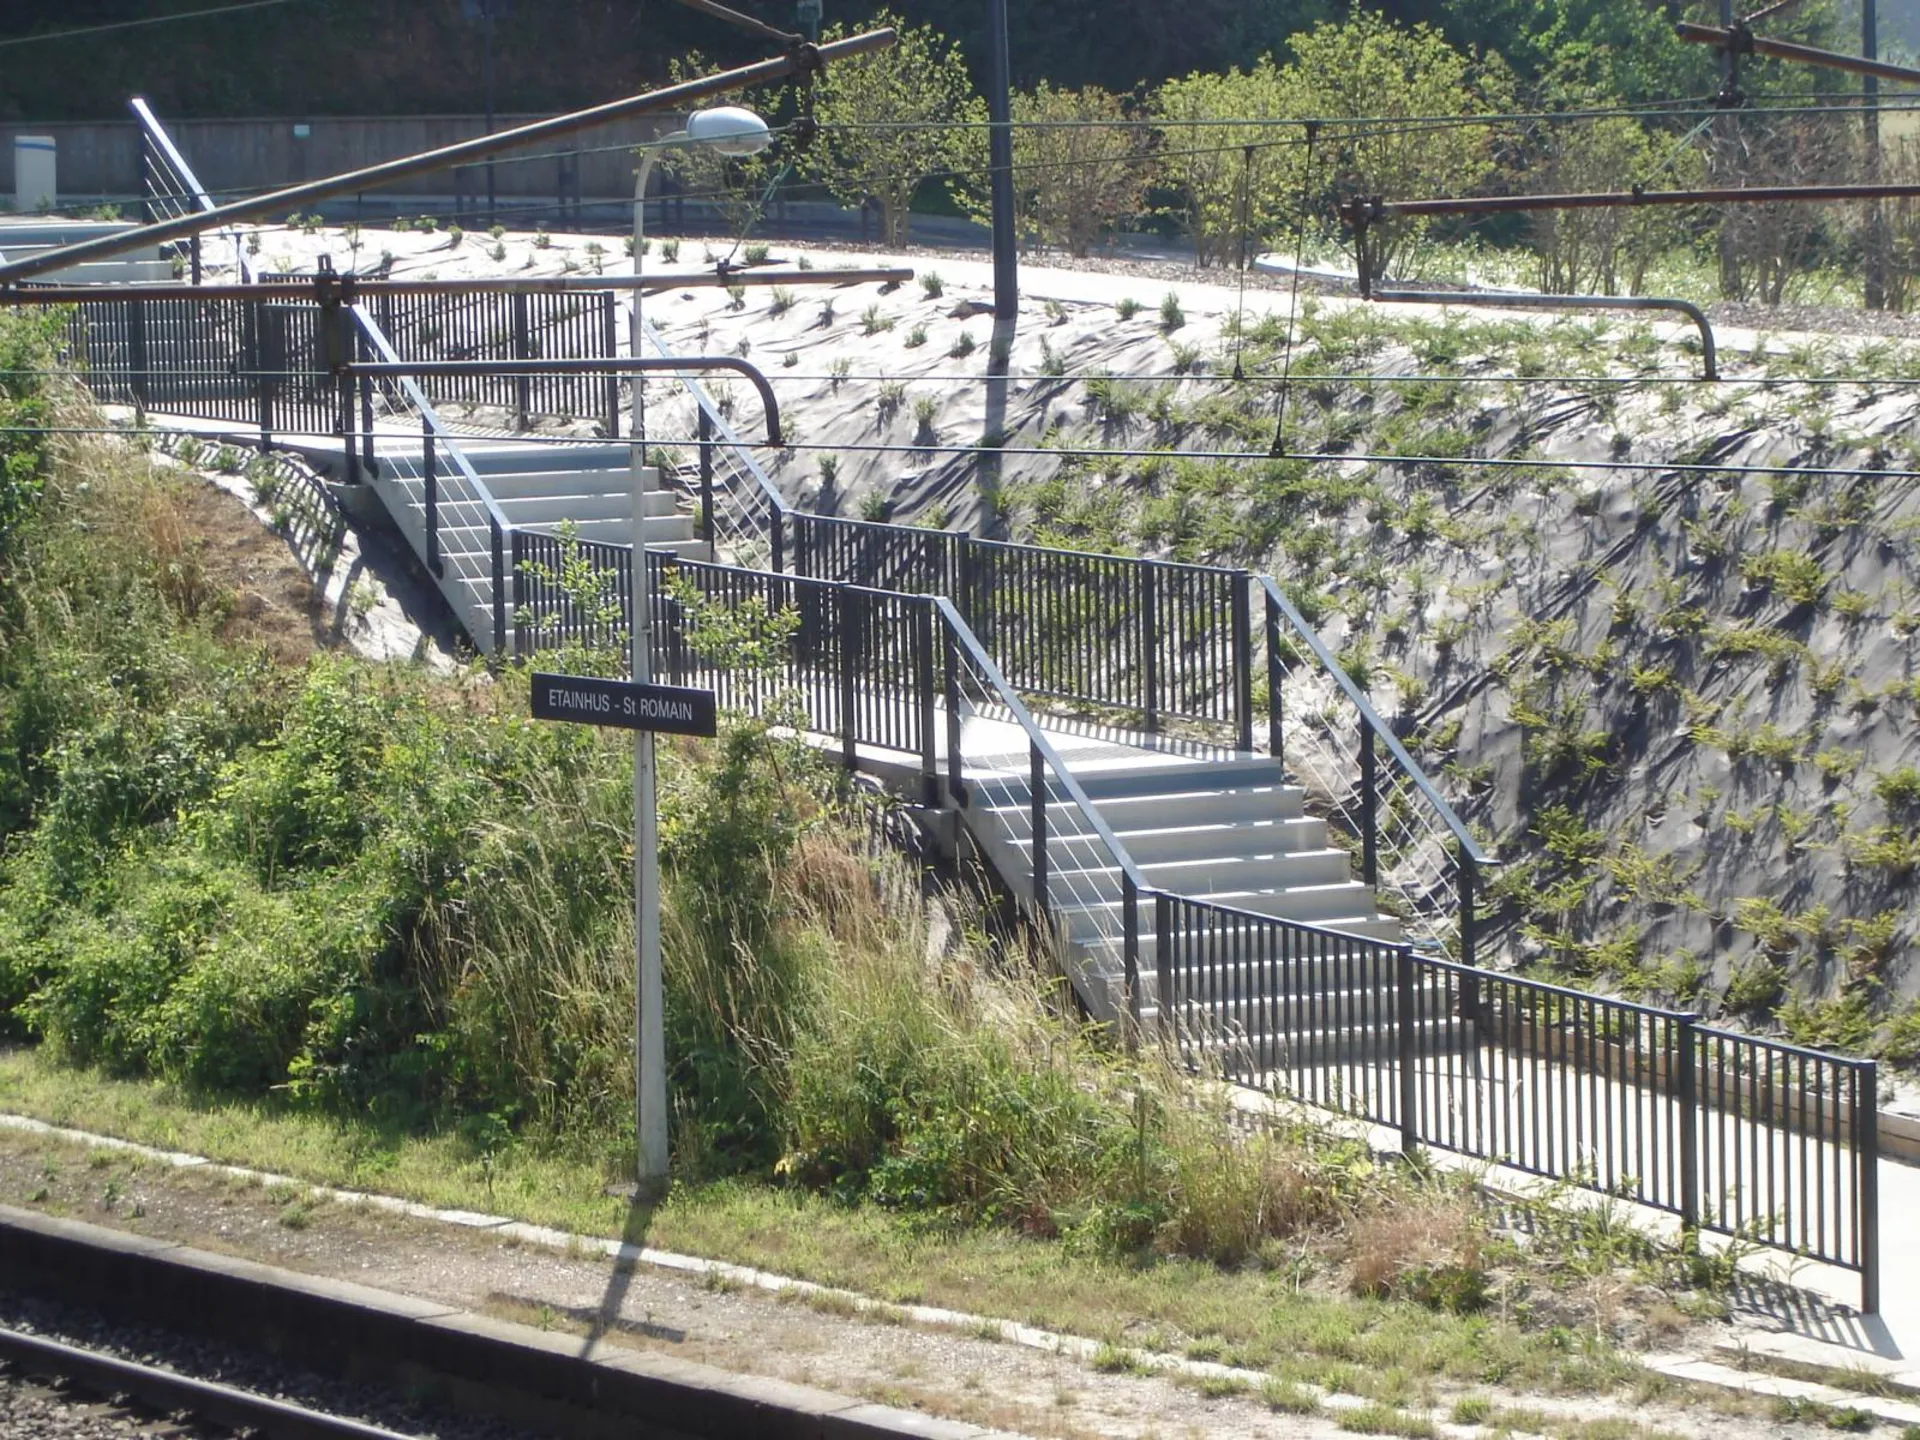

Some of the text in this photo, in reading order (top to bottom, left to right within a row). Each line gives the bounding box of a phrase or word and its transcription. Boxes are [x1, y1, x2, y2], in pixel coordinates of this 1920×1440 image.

[548, 689, 610, 712] ETAINHUS
[623, 696, 636, 715] St
[640, 698, 692, 720] ROMAIN
